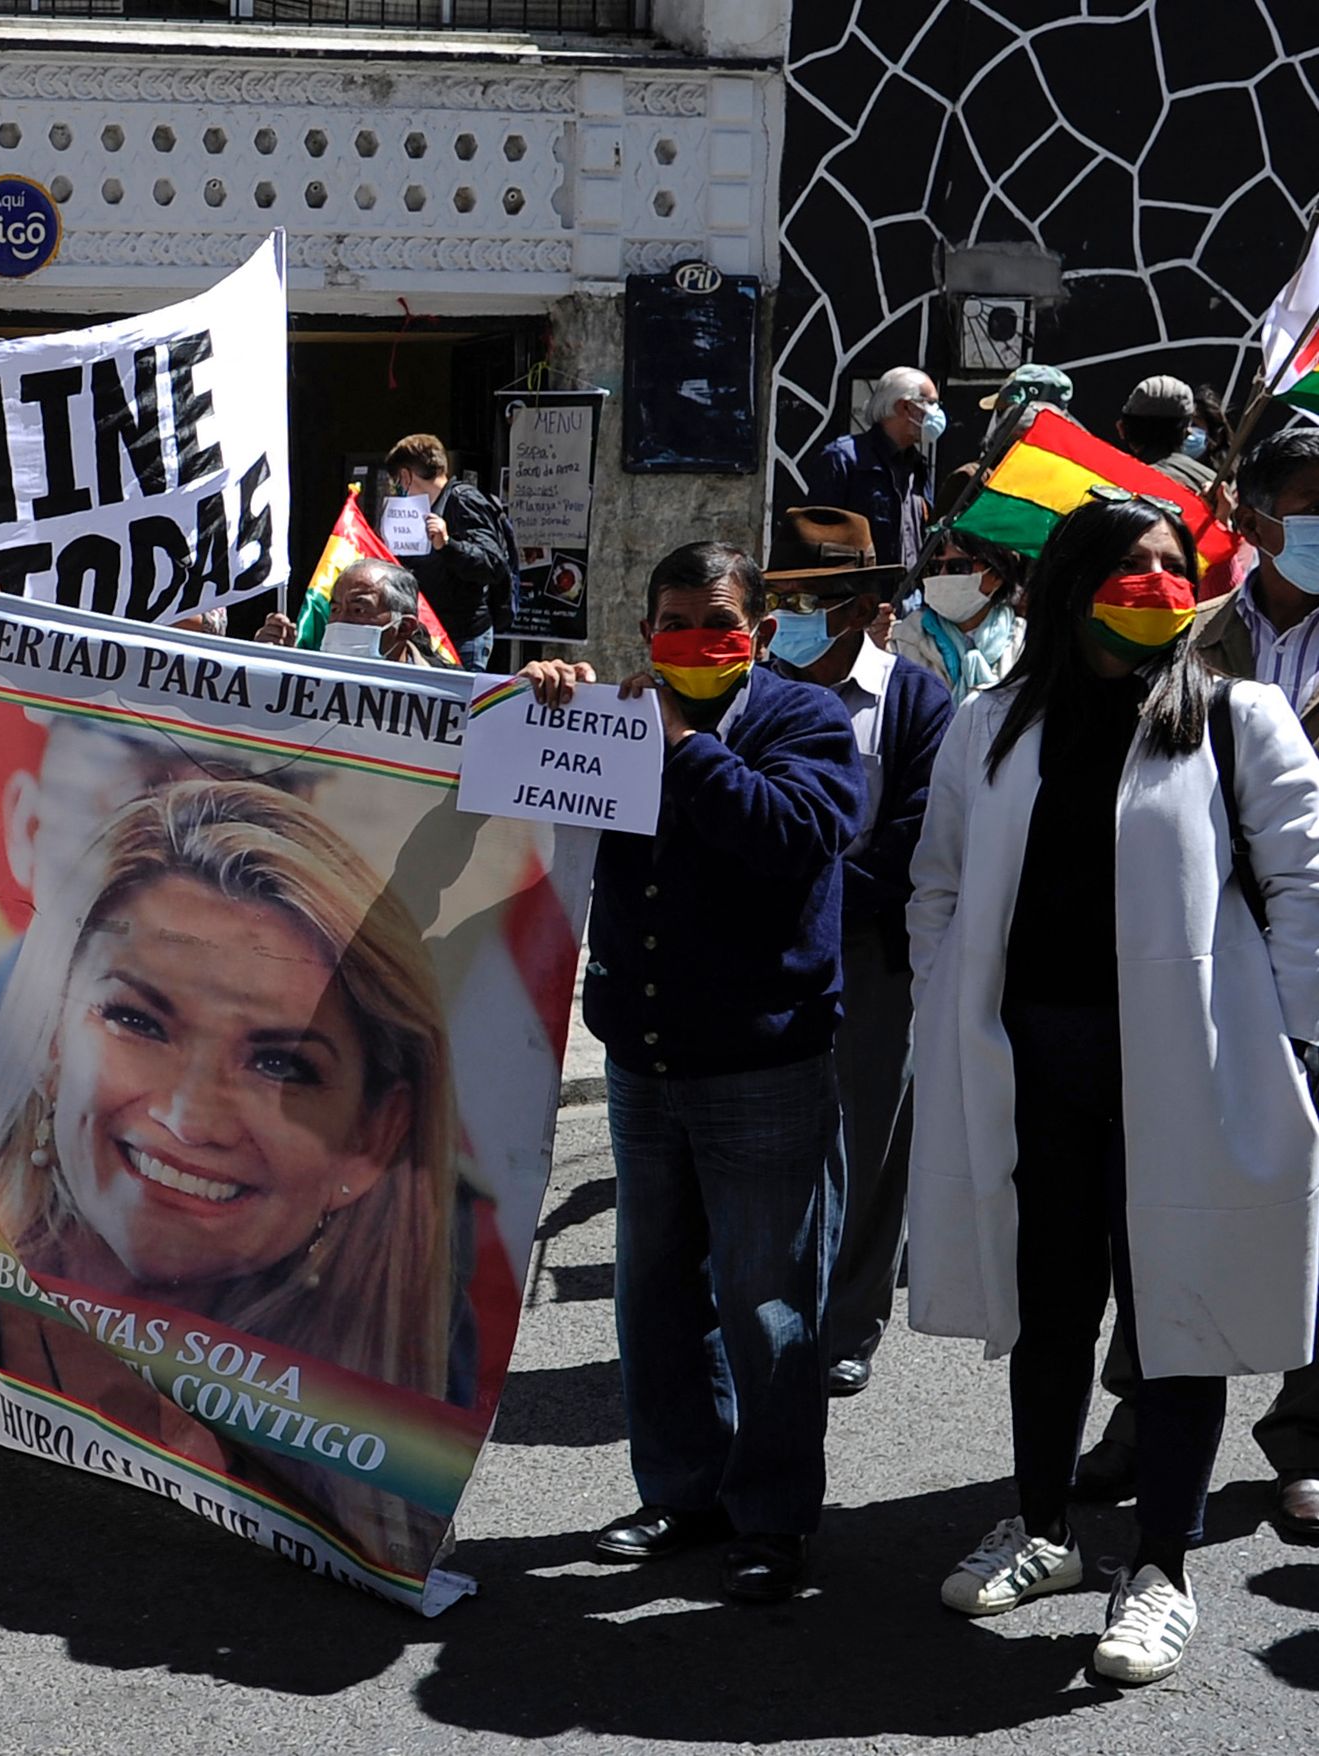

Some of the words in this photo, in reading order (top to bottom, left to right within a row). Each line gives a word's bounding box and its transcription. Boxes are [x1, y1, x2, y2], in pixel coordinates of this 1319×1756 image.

[682, 266, 713, 289] Pil
[138, 646, 252, 709] PARA
[265, 672, 467, 746] JEANINE
[525, 703, 648, 742] LIBERTAD
[540, 748, 603, 777] PARA
[513, 784, 618, 820] JEANINE
[176, 1330, 302, 1403] SOLA
[171, 1373, 387, 1472] CONTIGO
